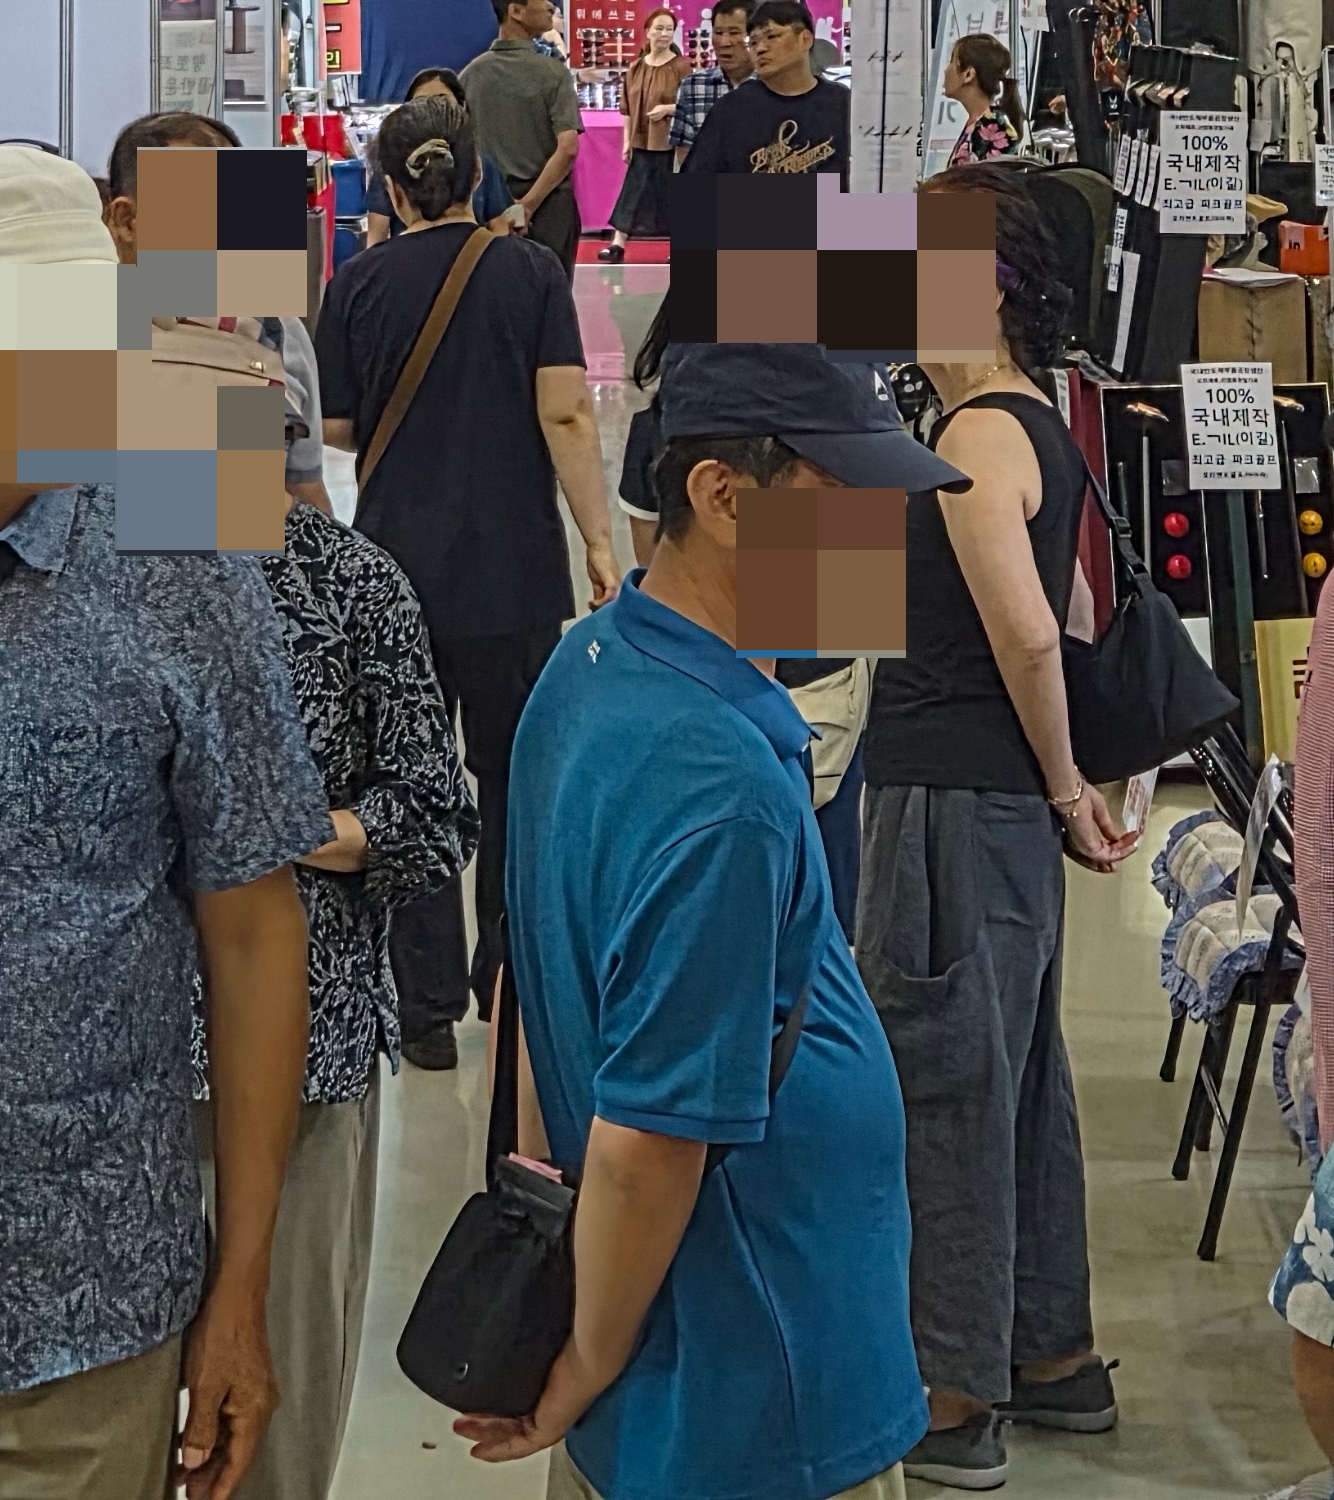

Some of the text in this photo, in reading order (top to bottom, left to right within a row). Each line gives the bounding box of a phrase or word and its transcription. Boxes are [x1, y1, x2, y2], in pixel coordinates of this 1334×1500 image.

[1181, 135, 1229, 151] 100%
[1166, 153, 1241, 173] 국내제작
[1205, 388, 1256, 404] 100%
[1191, 407, 1271, 428] 국내제작
[1191, 453, 1277, 466] 최고급 파크골프
